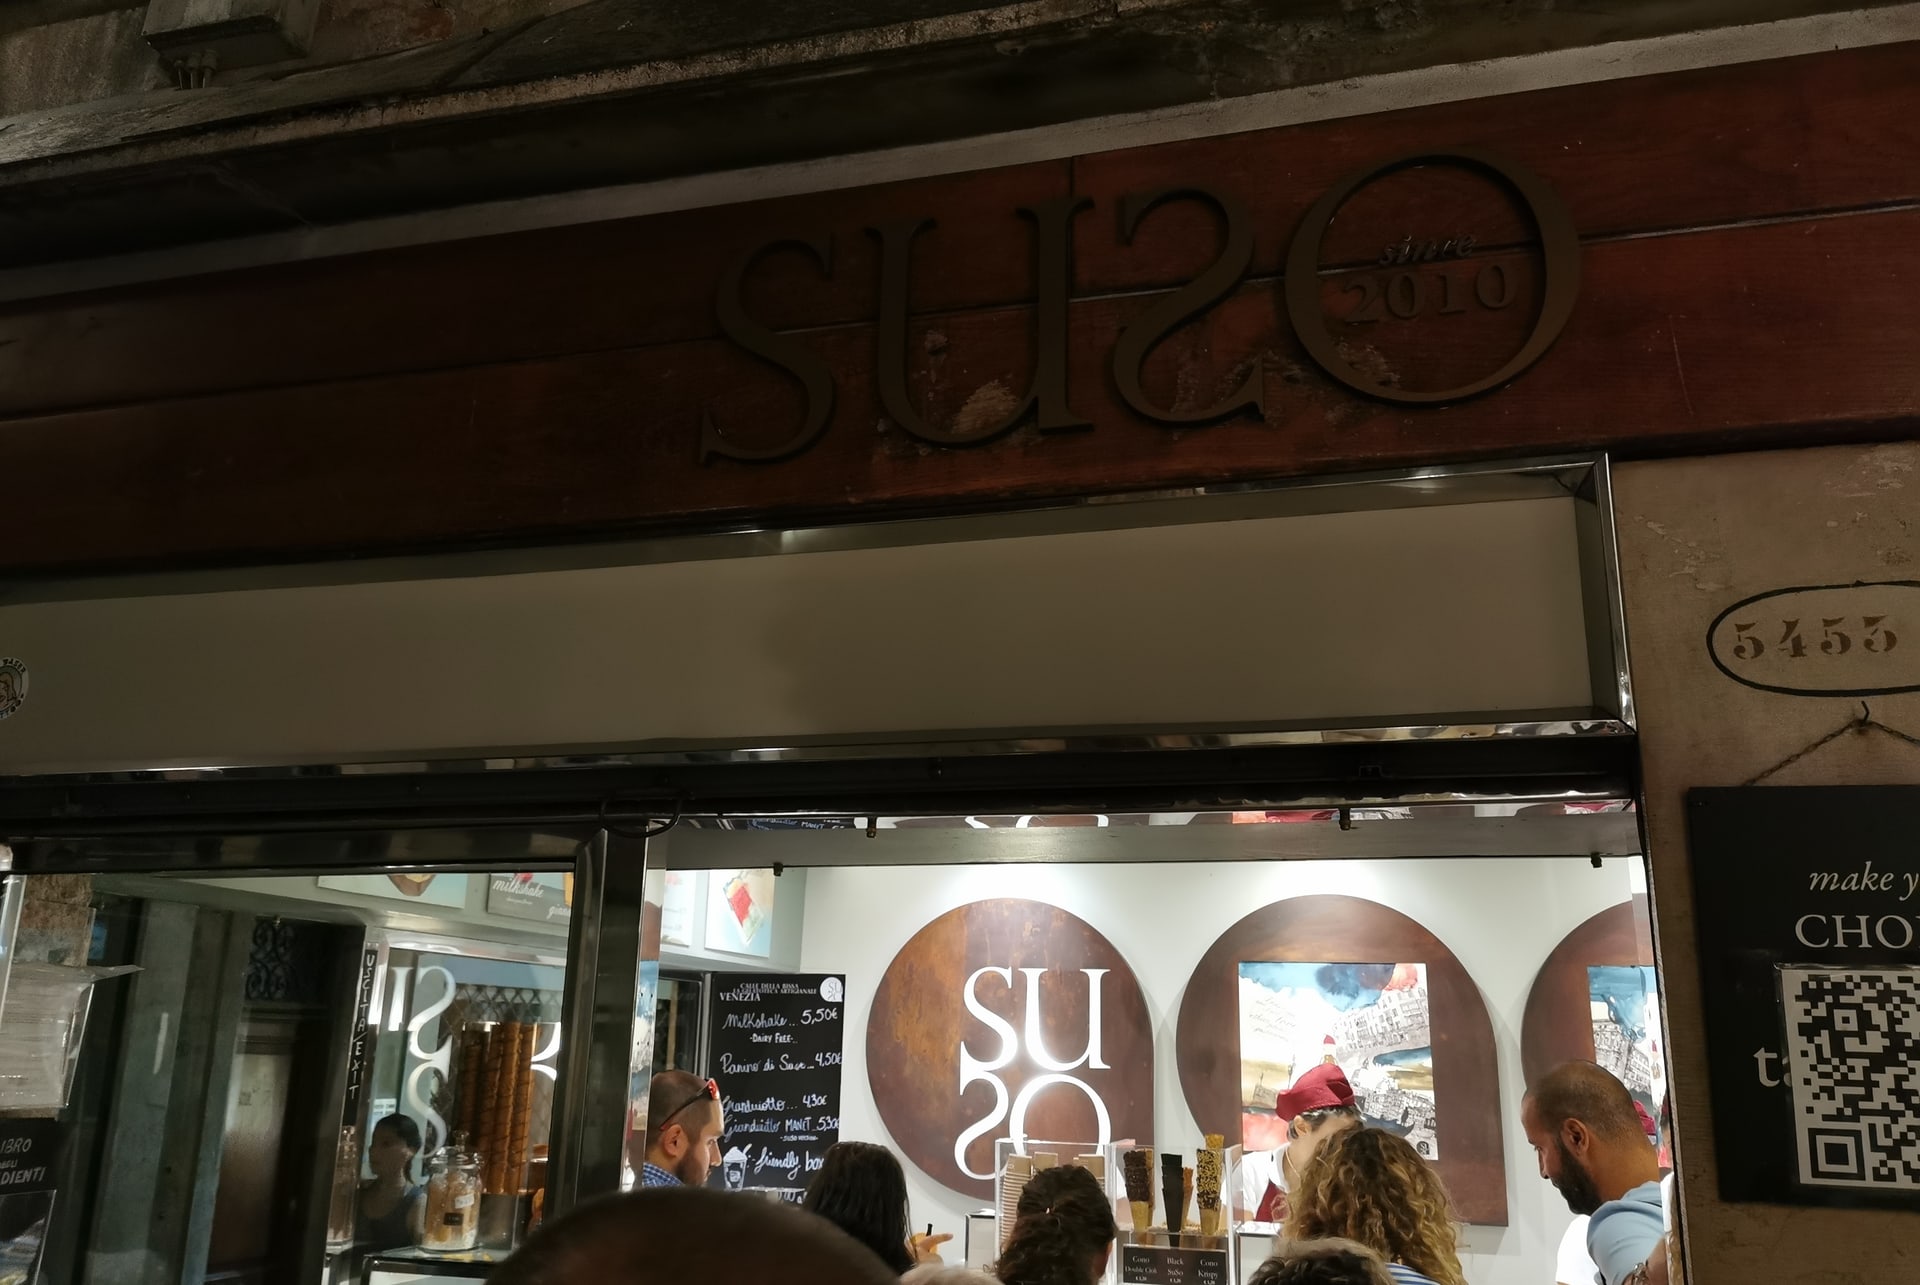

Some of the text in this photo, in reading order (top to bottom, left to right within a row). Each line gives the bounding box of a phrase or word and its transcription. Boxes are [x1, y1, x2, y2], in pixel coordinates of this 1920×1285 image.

[1378, 234, 1477, 266] since
[1344, 263, 1517, 324] 2010
[1733, 615, 1898, 660] 5453
[1809, 861, 1894, 891] make
[1795, 914, 1920, 949] CHO
[720, 992, 761, 1002] VENEZIA
[763, 1058, 776, 1072] di
[0, 1137, 33, 1154] IBRO
[0, 1166, 47, 1186] DIENTI
[1166, 1257, 1184, 1266] Black
[1200, 1260, 1218, 1268] Cono
